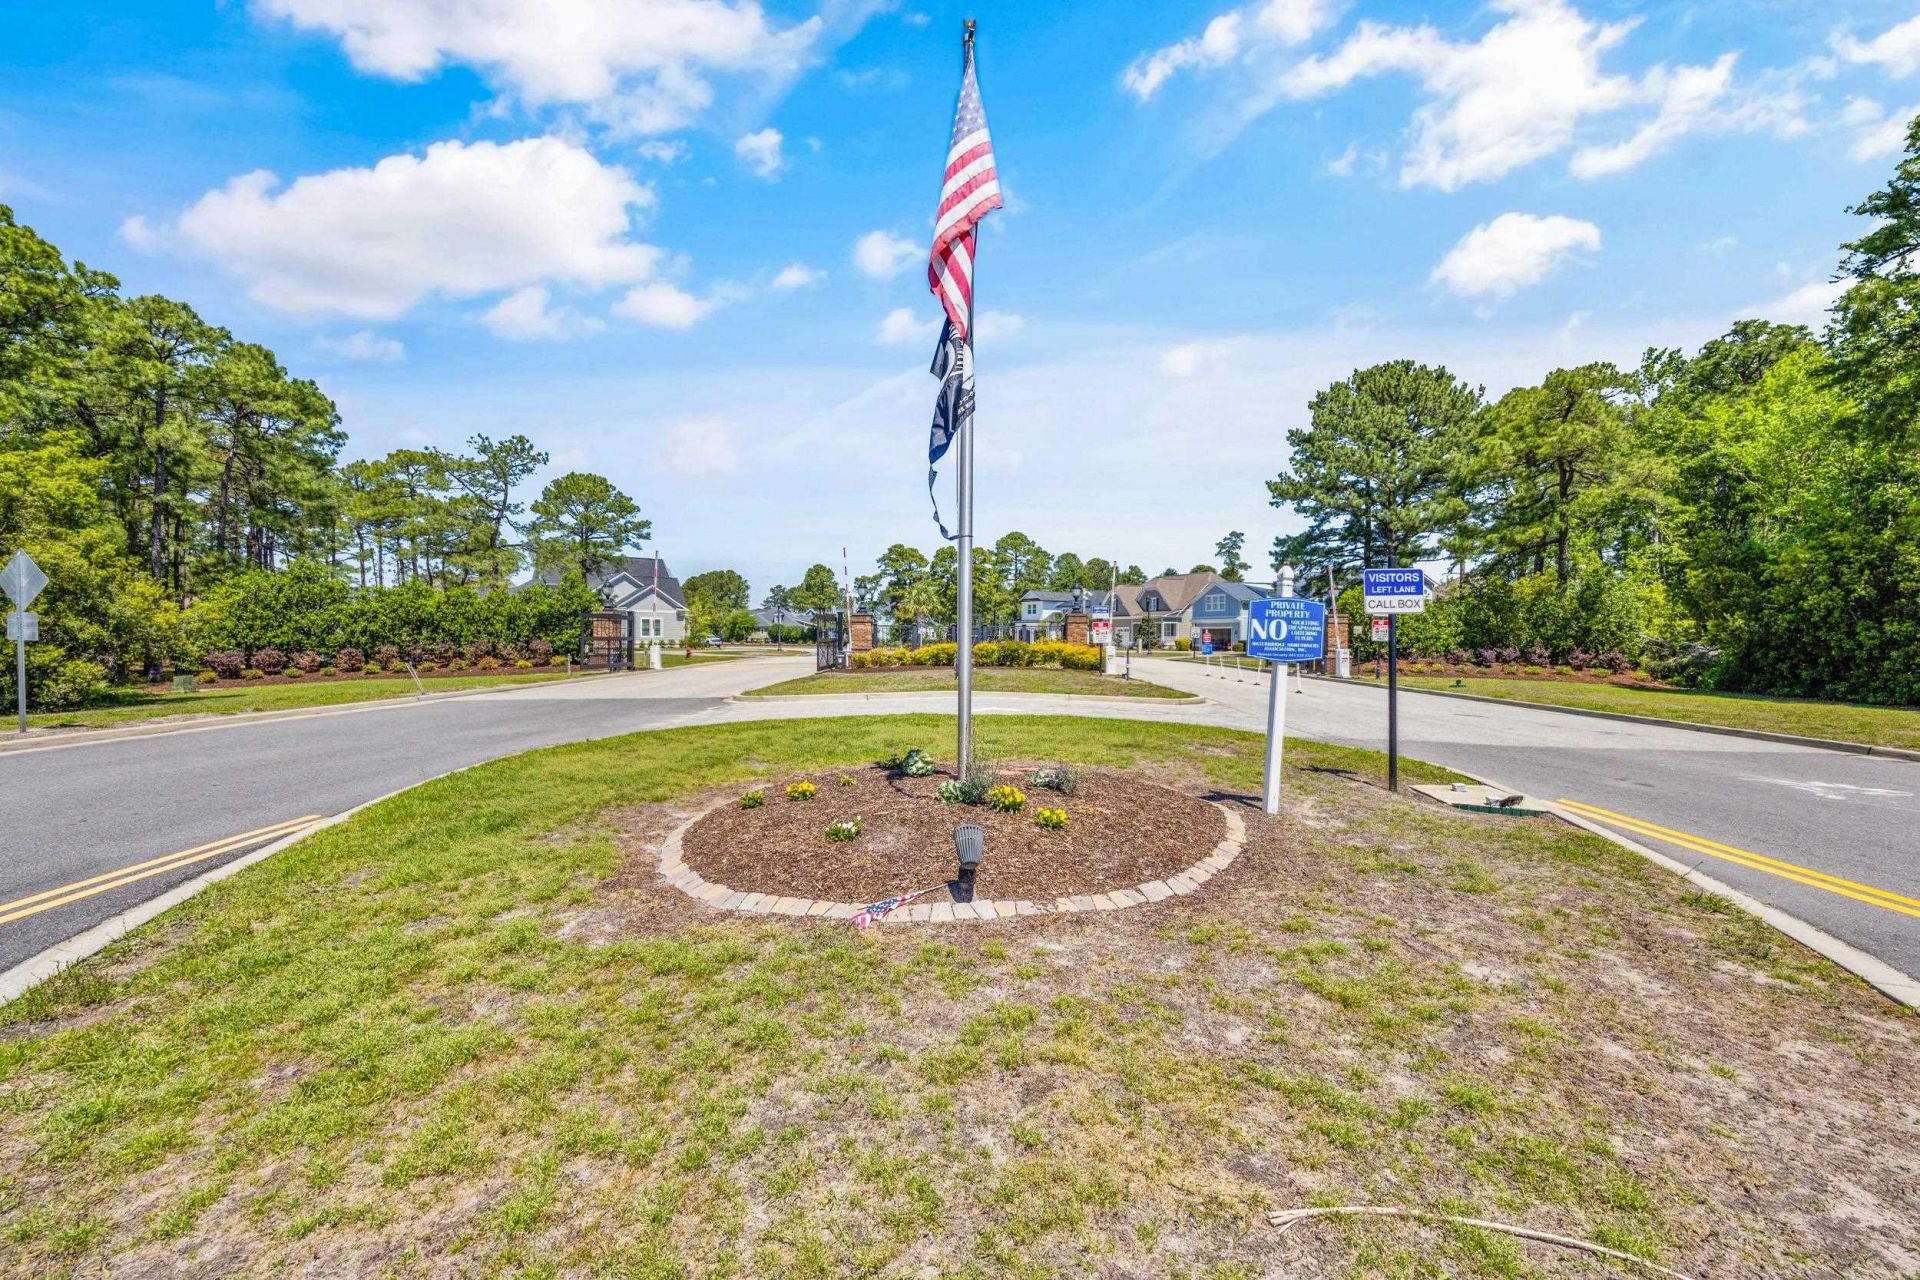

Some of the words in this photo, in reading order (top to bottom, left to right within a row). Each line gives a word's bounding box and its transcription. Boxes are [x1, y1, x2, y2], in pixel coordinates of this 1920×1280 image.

[1368, 573, 1420, 583] VISITORS
[1270, 601, 1306, 610] PRIVATE
[1368, 600, 1396, 609] CALL
[1397, 600, 1421, 609] BOX
[1265, 609, 1311, 618] PROPERTY
[1250, 618, 1288, 640] NO
